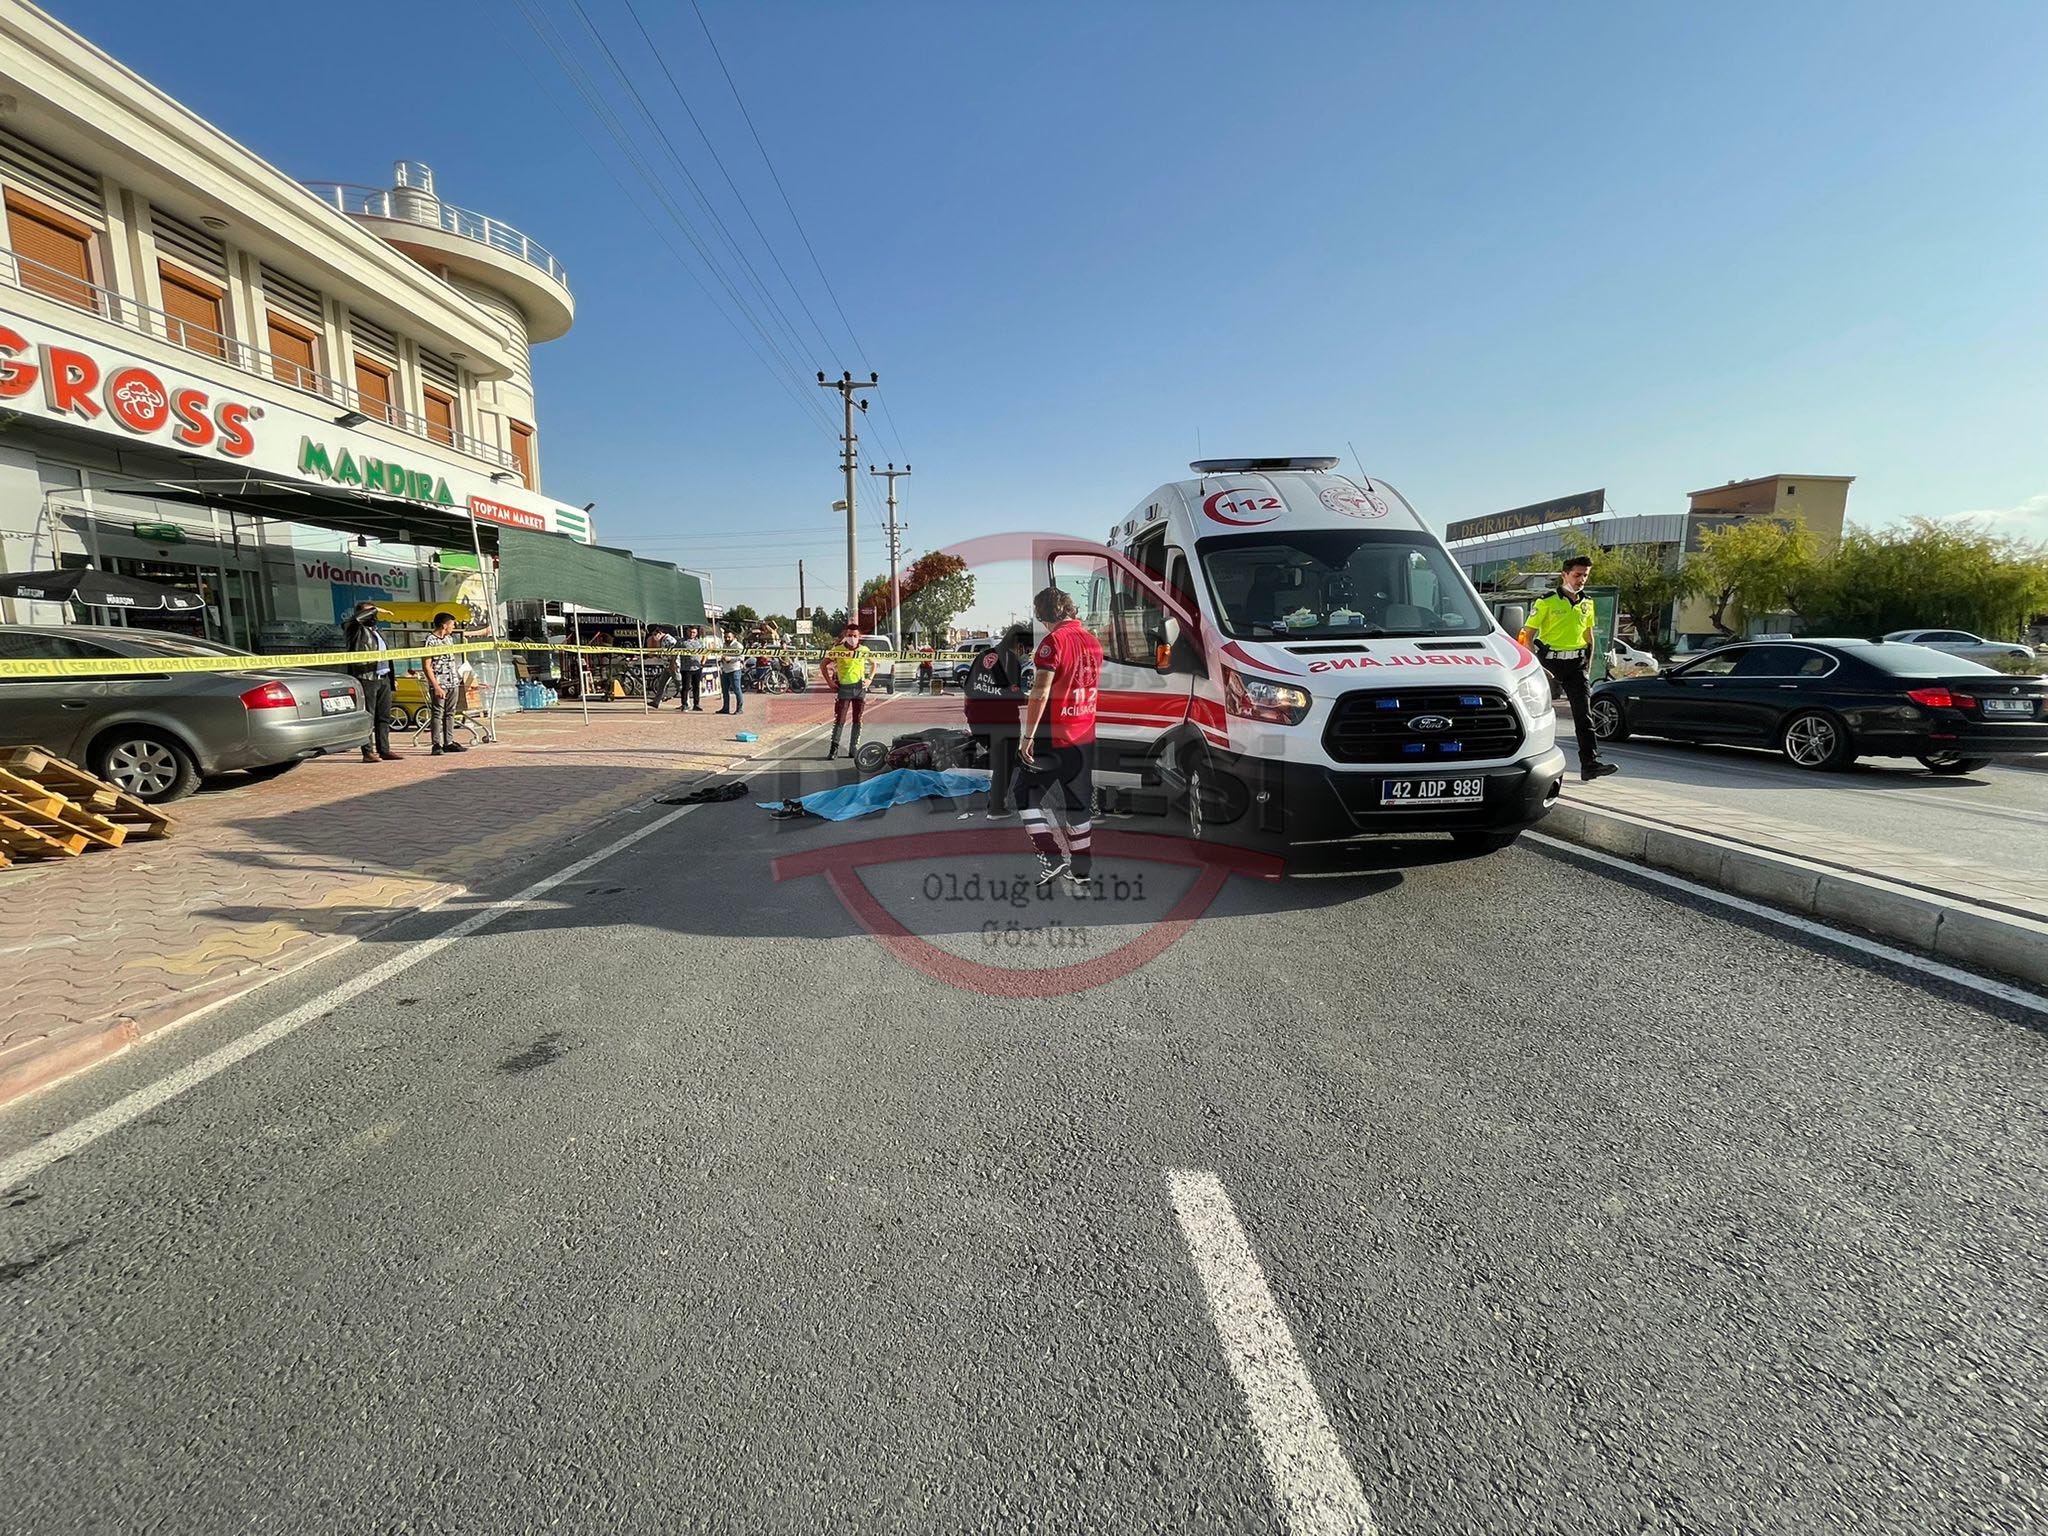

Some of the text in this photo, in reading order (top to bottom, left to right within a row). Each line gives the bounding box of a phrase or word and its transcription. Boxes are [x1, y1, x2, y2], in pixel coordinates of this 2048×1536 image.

[297, 435, 455, 506] MANDIRA
[473, 500, 544, 529] TOPTAN MARKET
[1221, 497, 1282, 514] 112
[1072, 687, 1097, 704] 112
[1418, 718, 1443, 729] Ford
[1392, 779, 1480, 798] 42 ADP 989
